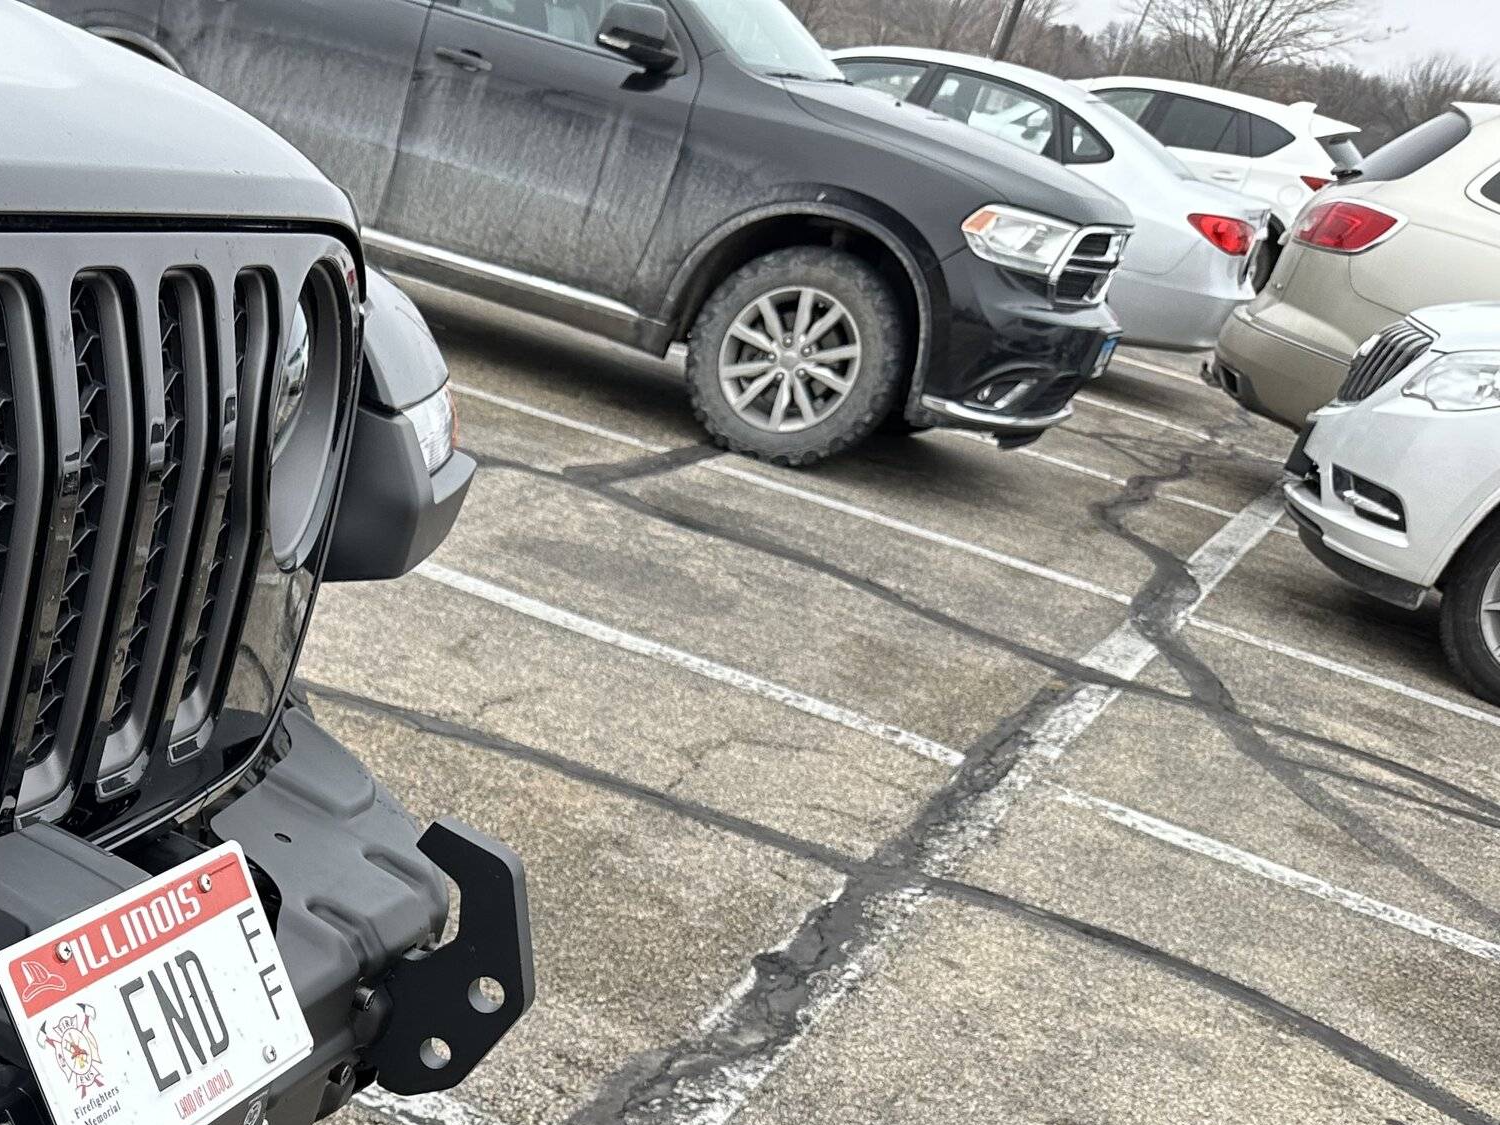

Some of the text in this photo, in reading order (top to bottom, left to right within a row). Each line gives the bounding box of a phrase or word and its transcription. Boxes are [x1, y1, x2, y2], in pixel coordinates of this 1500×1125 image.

[69, 881, 201, 976] ILLINOIS
[119, 950, 229, 1092] END
[74, 1086, 120, 1120] Firefighters
[174, 1093, 197, 1120] LAND
[202, 1069, 234, 1101] LINCOLN
